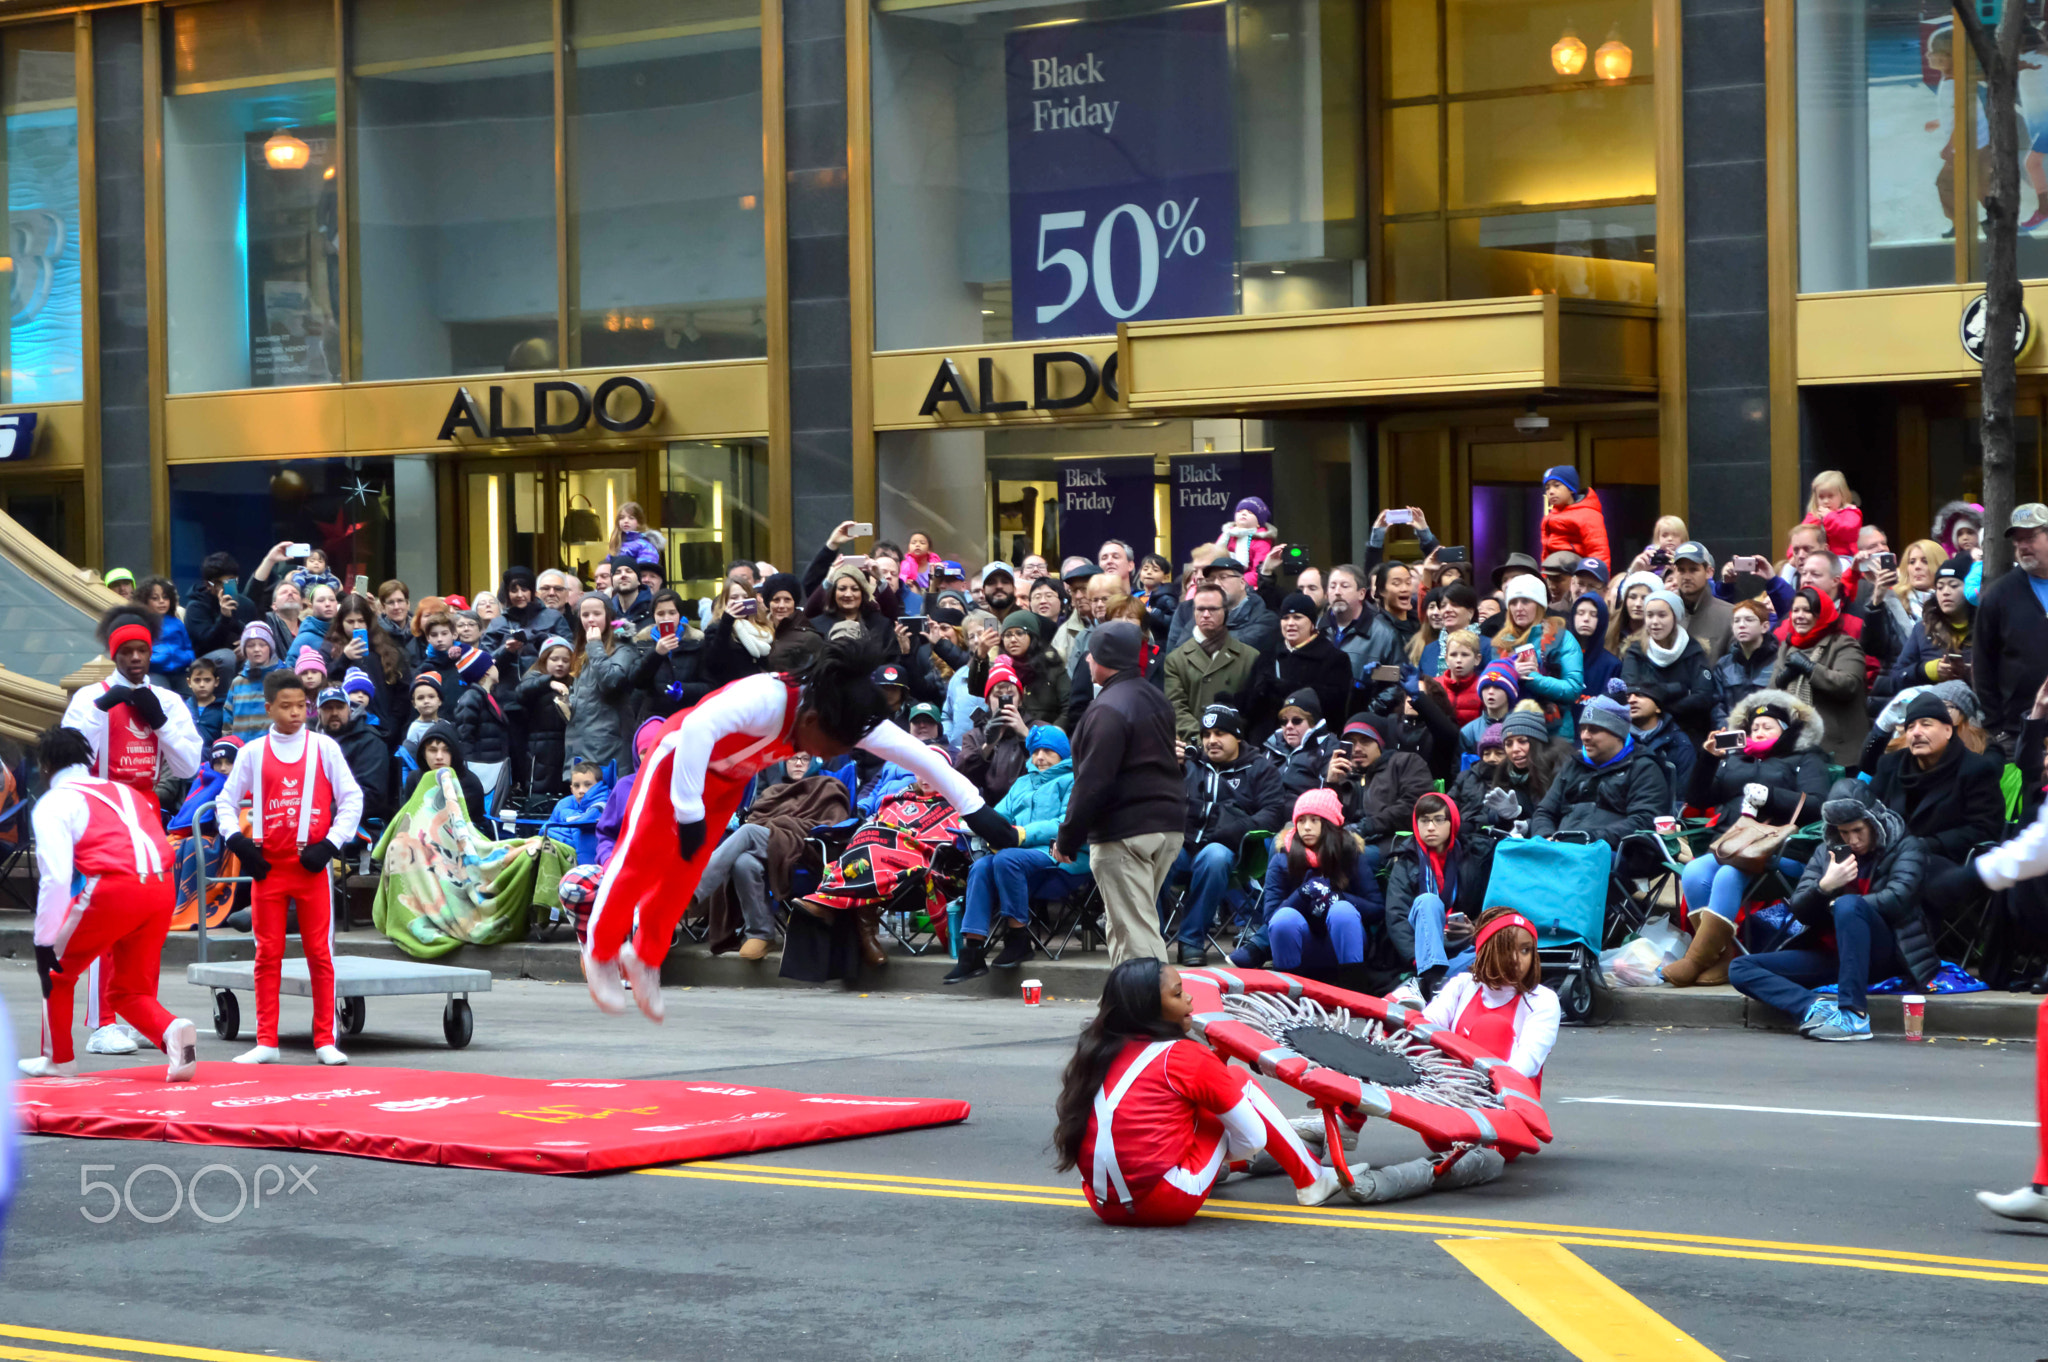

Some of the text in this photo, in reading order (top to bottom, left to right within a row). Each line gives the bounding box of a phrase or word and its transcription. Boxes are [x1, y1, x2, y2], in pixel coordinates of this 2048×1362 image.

[1031, 53, 1105, 90] Black
[1033, 96, 1120, 133] Friday
[1037, 197, 1206, 323] 50%
[437, 376, 655, 440] ALDO
[1065, 468, 1107, 487] Black
[1179, 463, 1222, 483] Black
[1065, 492, 1115, 514] Friday
[1179, 488, 1230, 511] Friday
